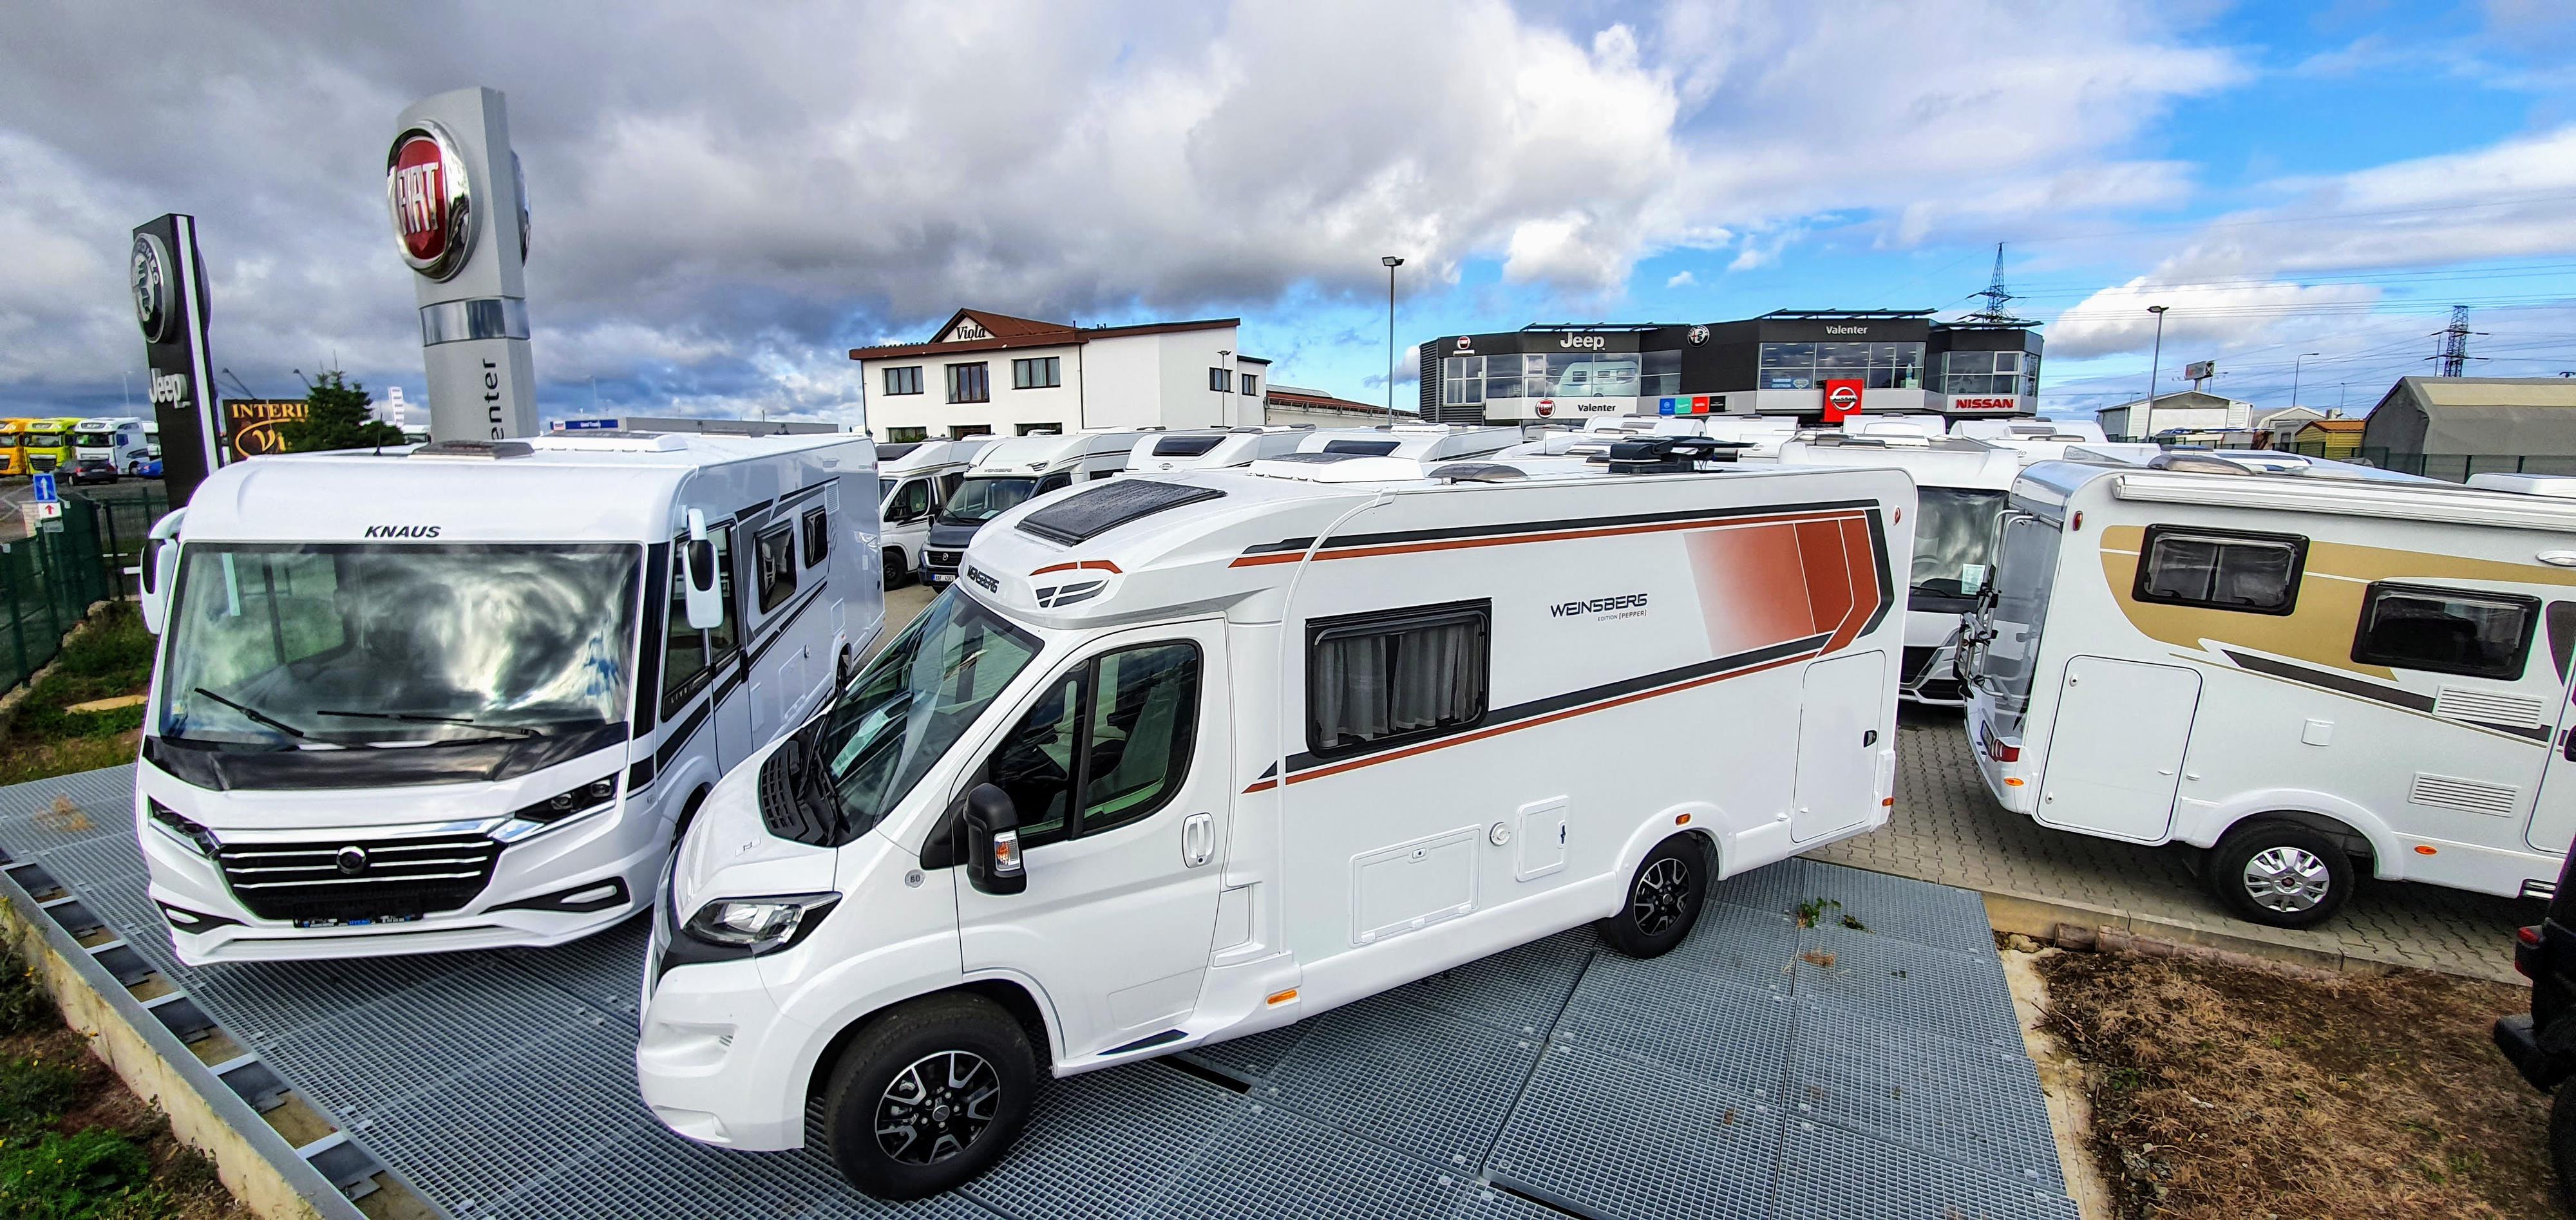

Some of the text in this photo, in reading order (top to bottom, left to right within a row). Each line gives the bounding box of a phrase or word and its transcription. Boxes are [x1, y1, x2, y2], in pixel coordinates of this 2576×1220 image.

[397, 162, 439, 236] FIAT
[956, 324, 986, 339] Viola
[1826, 325, 1868, 334] Valenter
[1560, 332, 1605, 350] Jeep
[149, 368, 188, 409] Jeep
[483, 359, 504, 440] enter
[1955, 399, 2013, 408] NISSAN
[365, 525, 441, 538] KNAUS
[1551, 594, 1647, 617] WEINSBERG
